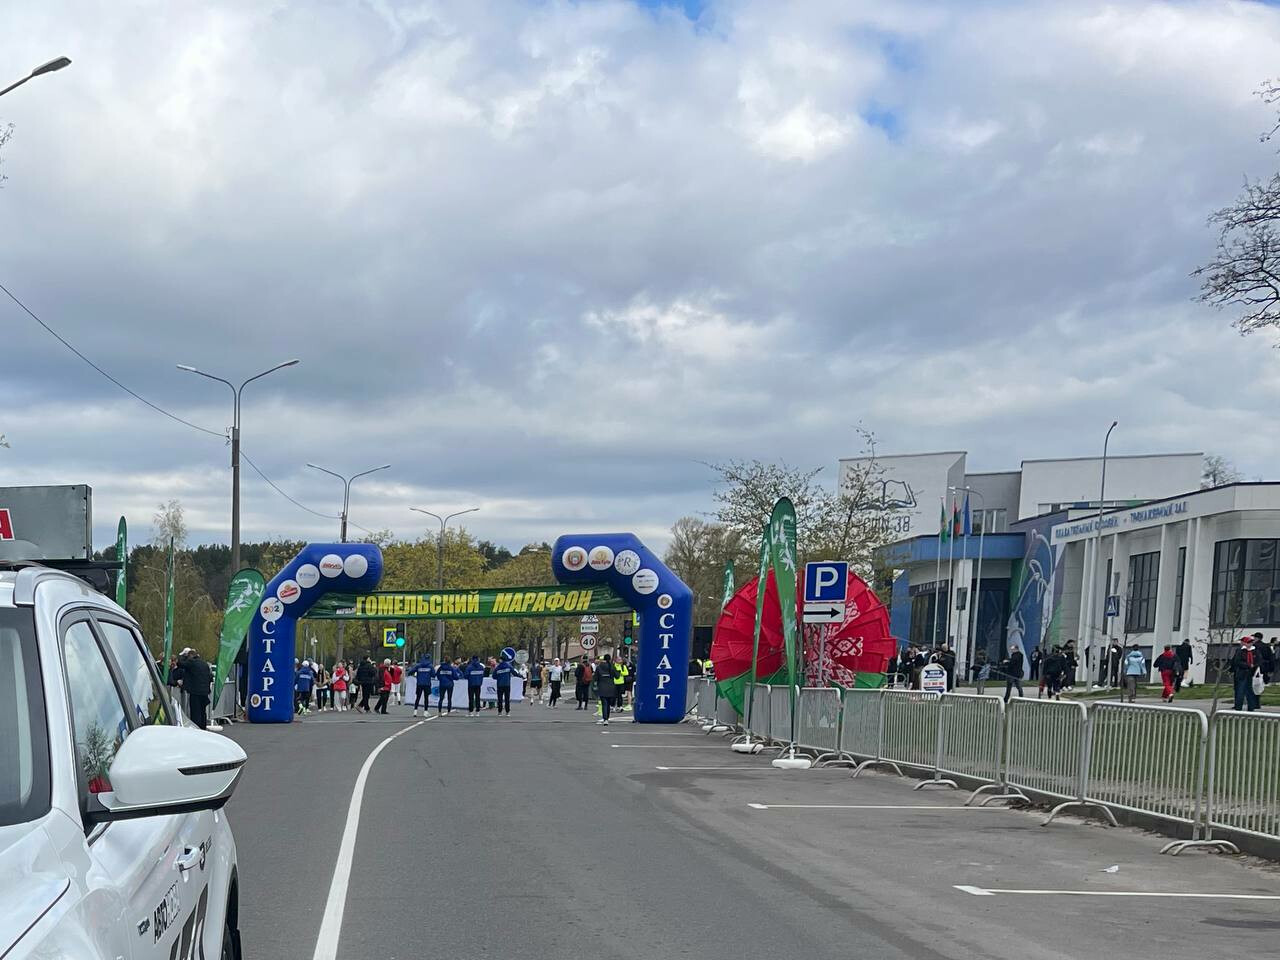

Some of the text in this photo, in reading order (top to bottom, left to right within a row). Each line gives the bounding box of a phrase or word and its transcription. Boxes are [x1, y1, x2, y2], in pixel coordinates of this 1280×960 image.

[815, 567, 839, 598] P
[356, 590, 593, 616] ГОМЕЛЬСКИЙ МАРАФОН
[583, 638, 595, 646] 40
[261, 620, 276, 711] СТАРТ
[655, 613, 675, 710] СТАРТ
